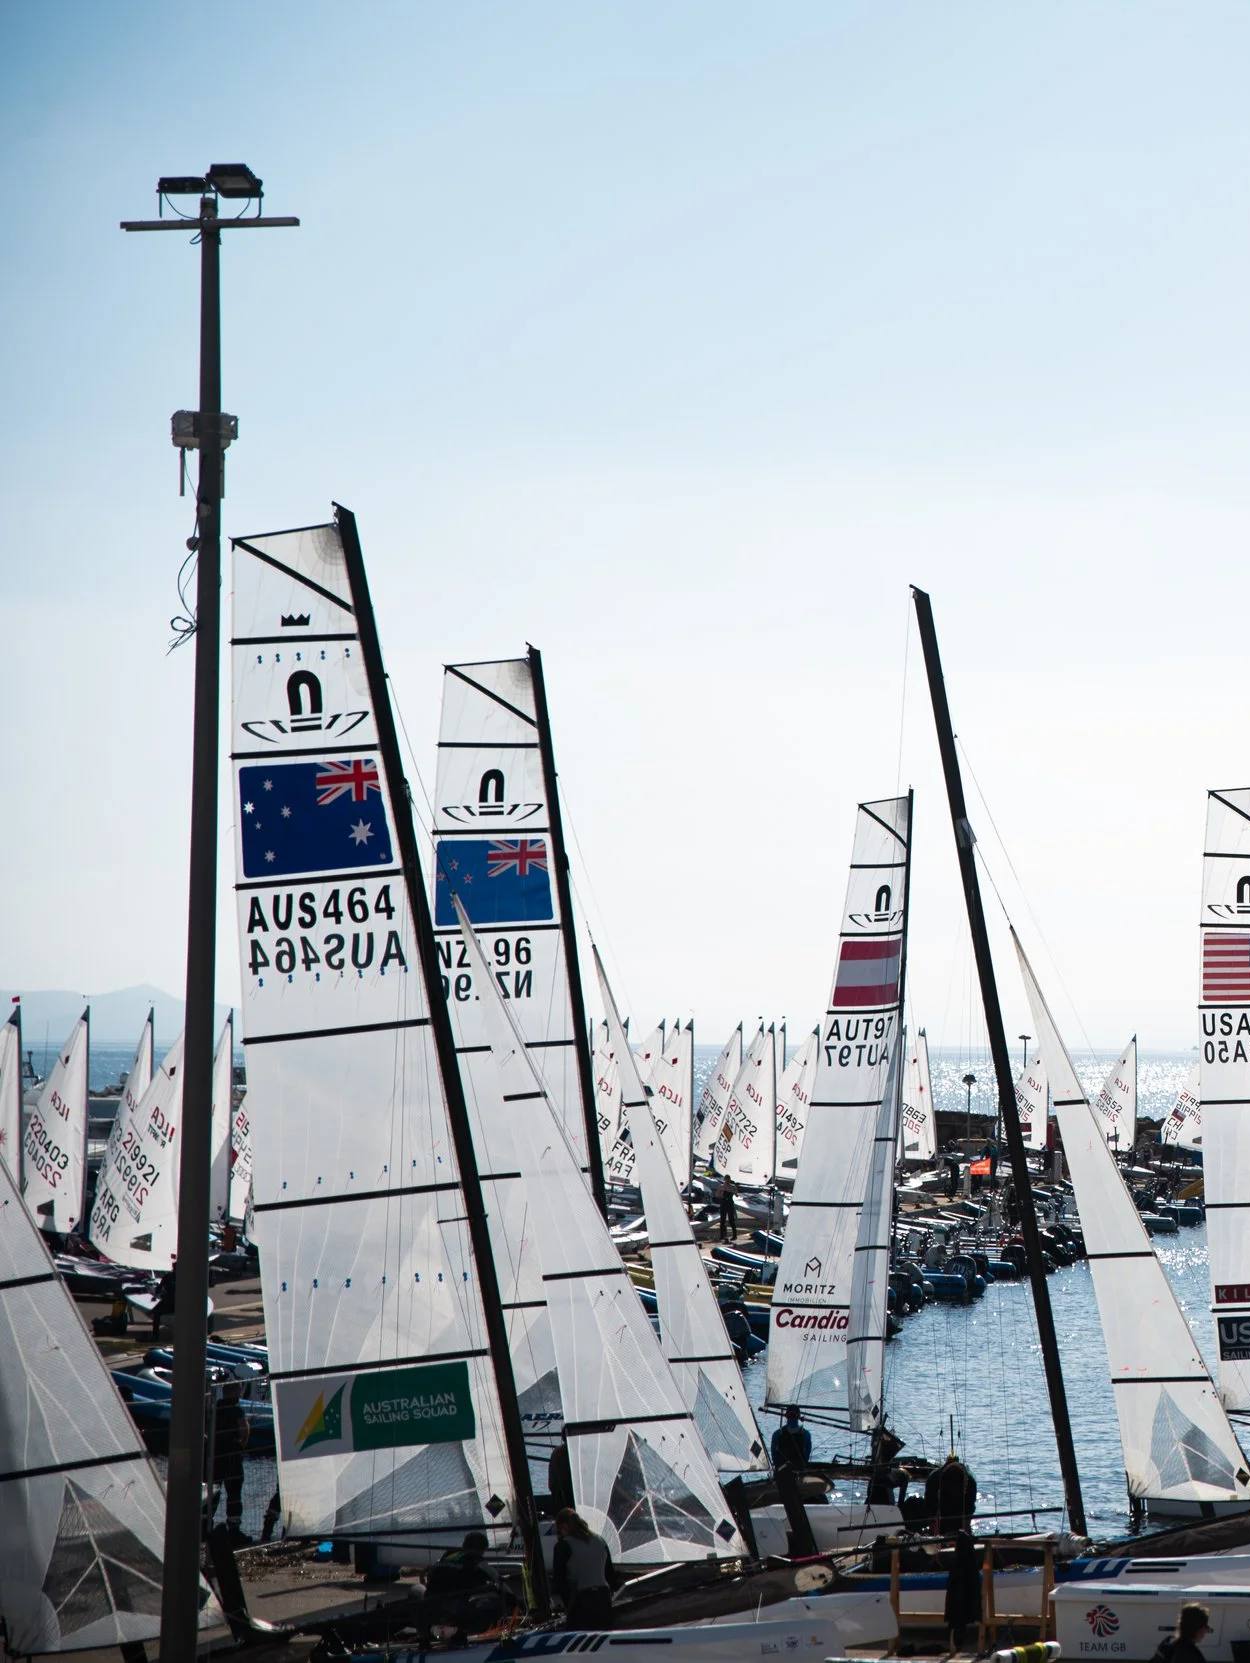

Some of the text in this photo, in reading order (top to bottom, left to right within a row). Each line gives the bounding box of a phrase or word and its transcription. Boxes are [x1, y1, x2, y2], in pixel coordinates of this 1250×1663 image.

[247, 884, 395, 933] AUS464
[436, 937, 531, 969] NZ96
[826, 1016, 893, 1041] AUT97
[1100, 1090, 1122, 1113] 211552
[1180, 1091, 1200, 1111] 2199
[729, 1099, 757, 1137] 217722
[776, 1104, 804, 1131] 01497
[903, 1103, 927, 1123] 0863
[1167, 1117, 1183, 1130] CHI
[30, 1115, 69, 1170] 220403
[612, 1142, 636, 1163] FRA
[718, 1134, 731, 1153] ESP
[123, 1132, 160, 1186] 219921
[100, 1188, 119, 1223] ARG
[783, 1284, 835, 1294] MORITZ
[803, 1334, 847, 1342] SAILING
[363, 1392, 455, 1416] AUSTRALIAN
[364, 1405, 457, 1424] SAILING SQUAD
[1080, 1642, 1126, 1652] TEAM GB
